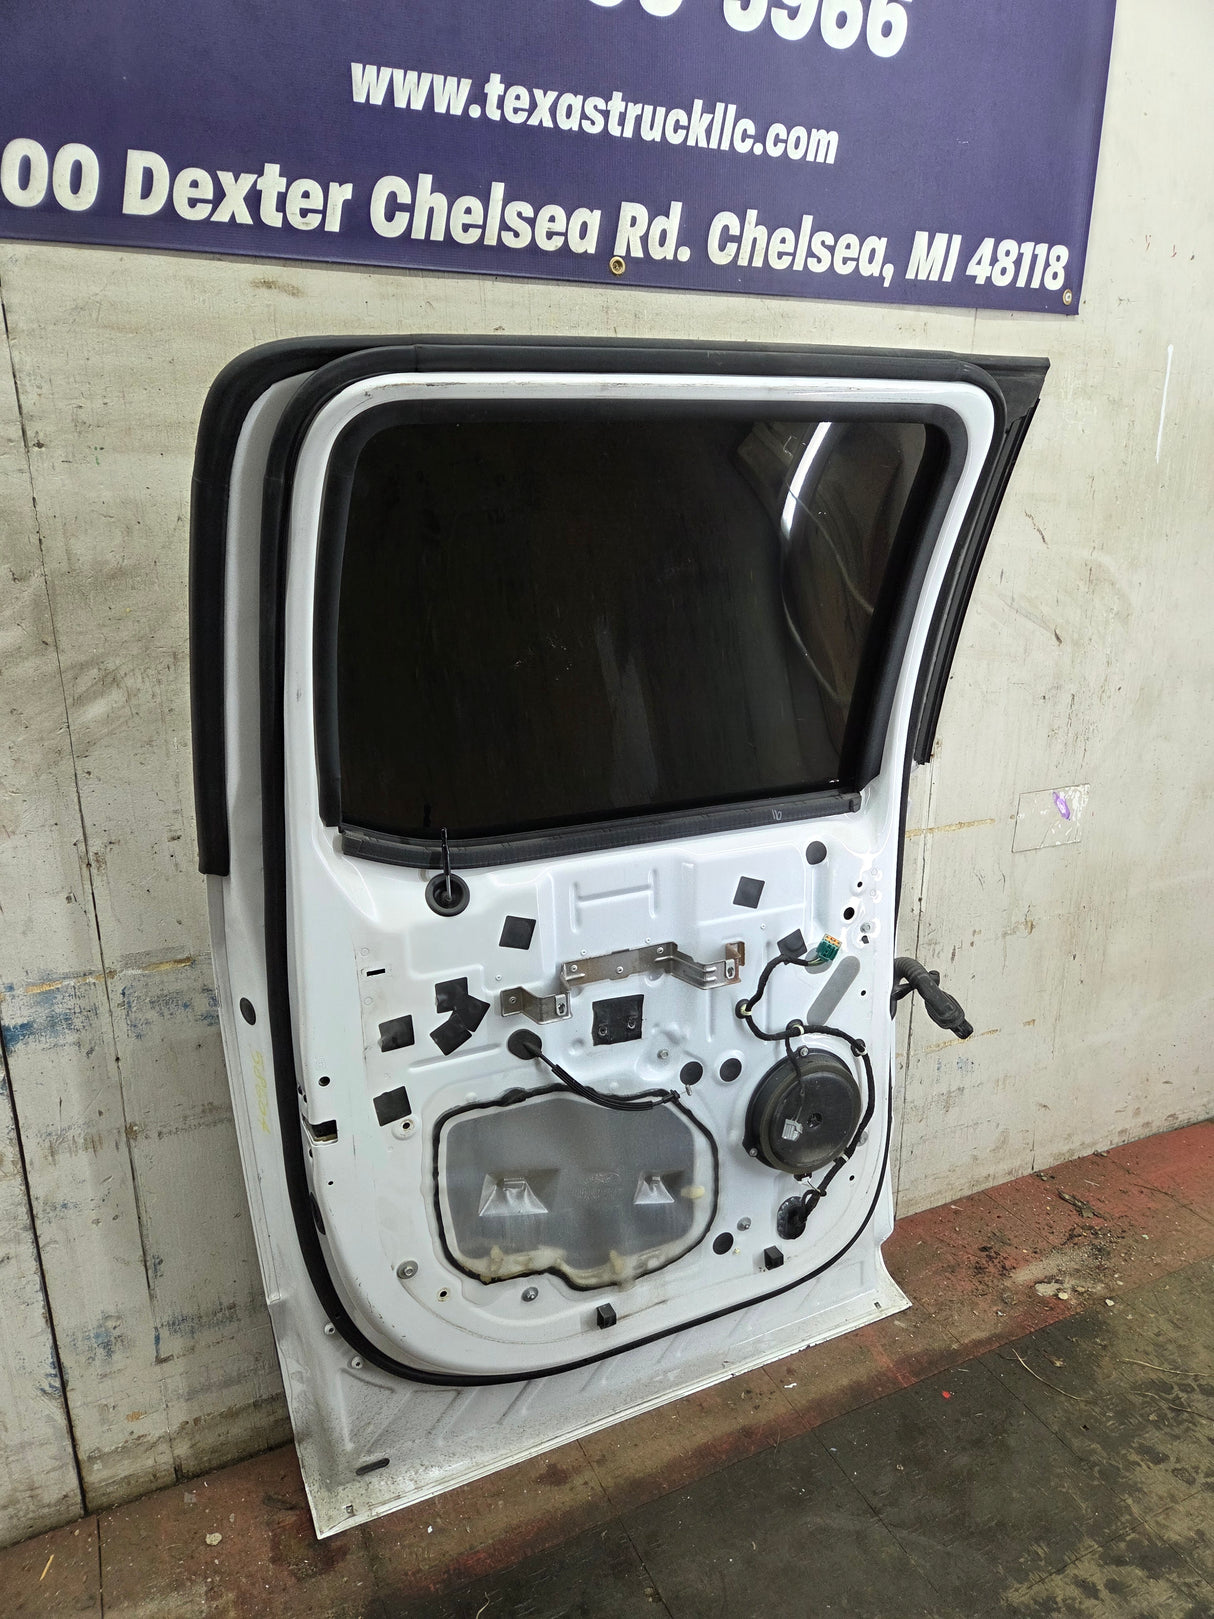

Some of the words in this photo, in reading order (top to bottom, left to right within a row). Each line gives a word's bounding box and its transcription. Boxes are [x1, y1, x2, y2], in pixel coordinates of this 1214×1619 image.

[350, 62, 840, 165] www.texastruckllc.com
[122, 149, 354, 233] Dexter
[369, 173, 602, 255] Chelsea
[613, 200, 691, 263] Rd.
[707, 208, 896, 288] Chelsea,
[905, 230, 963, 283] MI
[965, 237, 1070, 291] 48118
